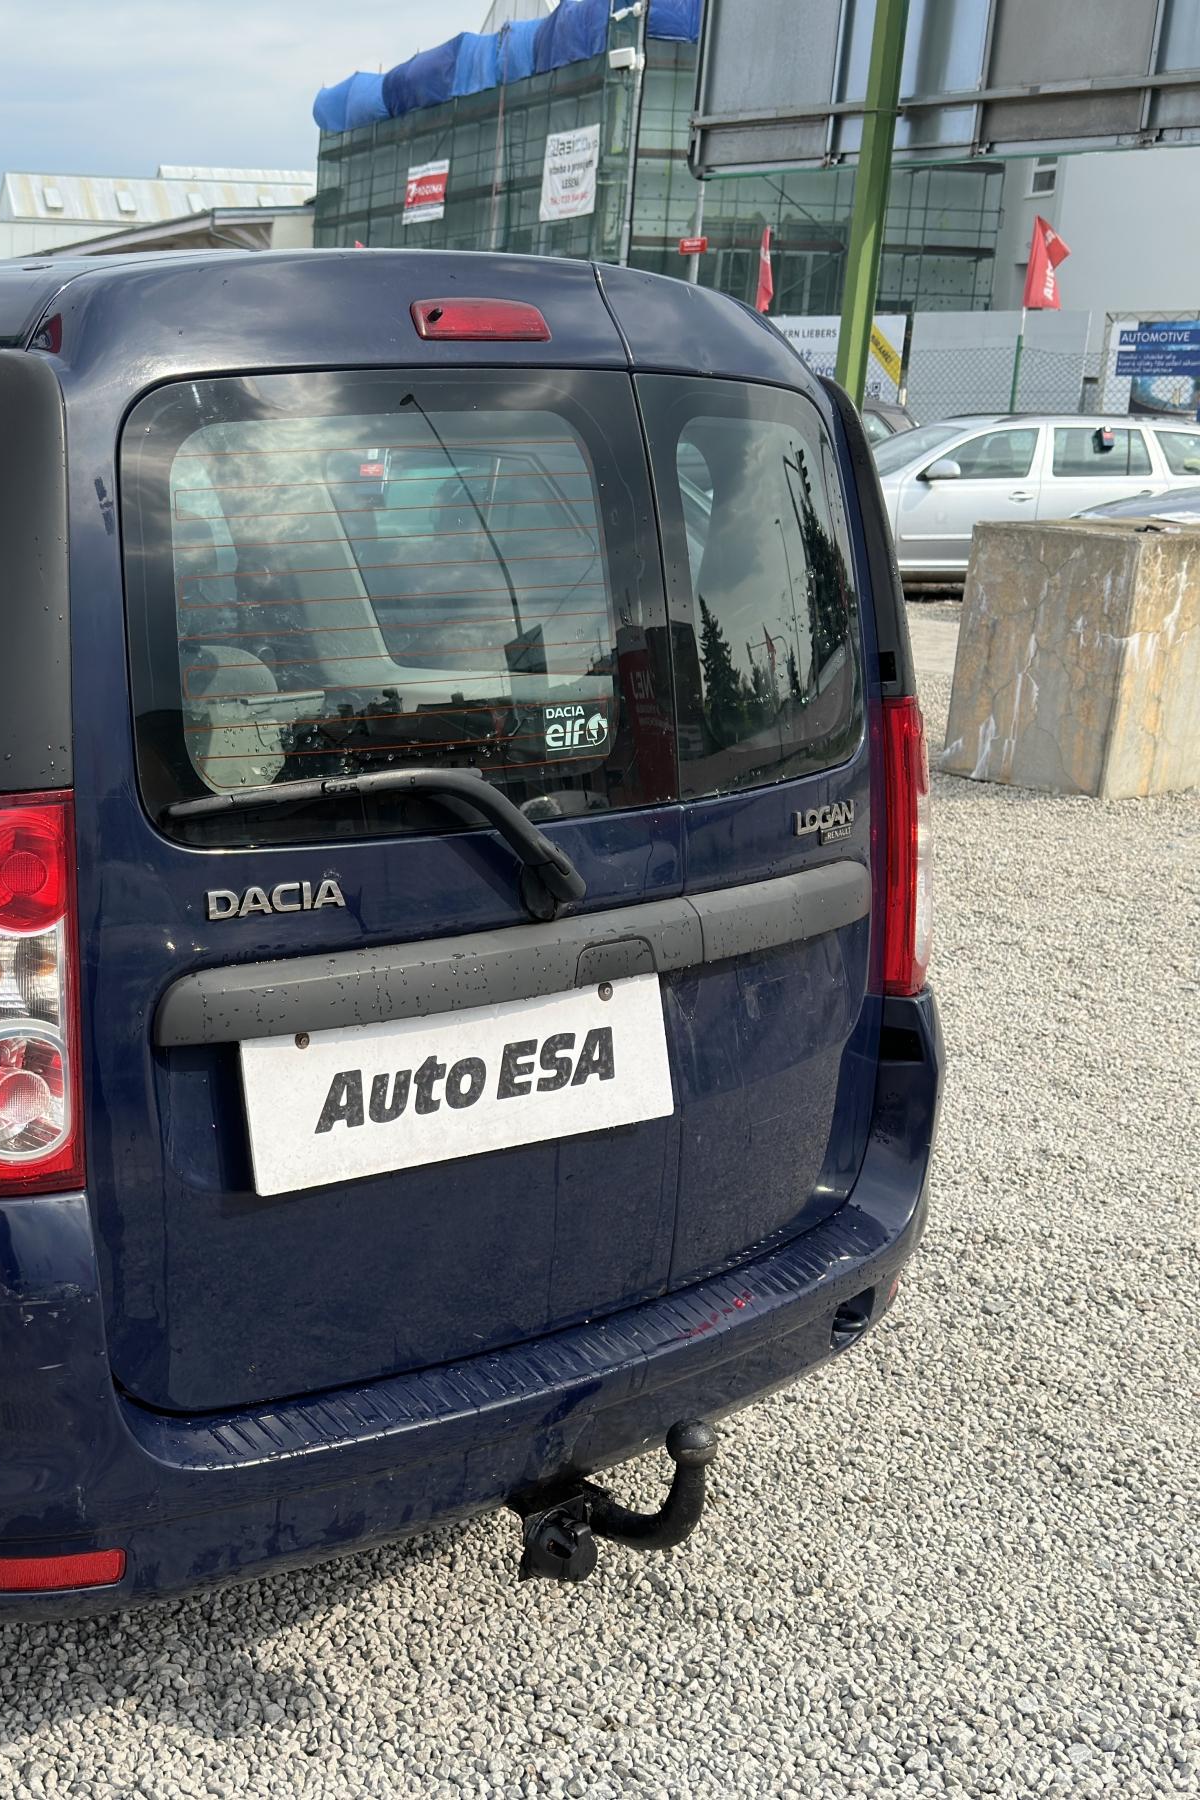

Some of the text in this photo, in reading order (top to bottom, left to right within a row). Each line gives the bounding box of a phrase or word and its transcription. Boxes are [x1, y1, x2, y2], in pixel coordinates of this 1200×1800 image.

[1043, 260, 1055, 301] Aut
[783, 328, 837, 339] ERN LIEBERS
[1121, 331, 1191, 343] AUTOMOTIVE
[545, 705, 585, 719] DACIA
[545, 718, 585, 747] elf
[794, 799, 854, 836] LOGAN
[826, 826, 853, 840] RENAULT
[207, 879, 346, 920] DACIA
[314, 1026, 616, 1135] Auto ESA
